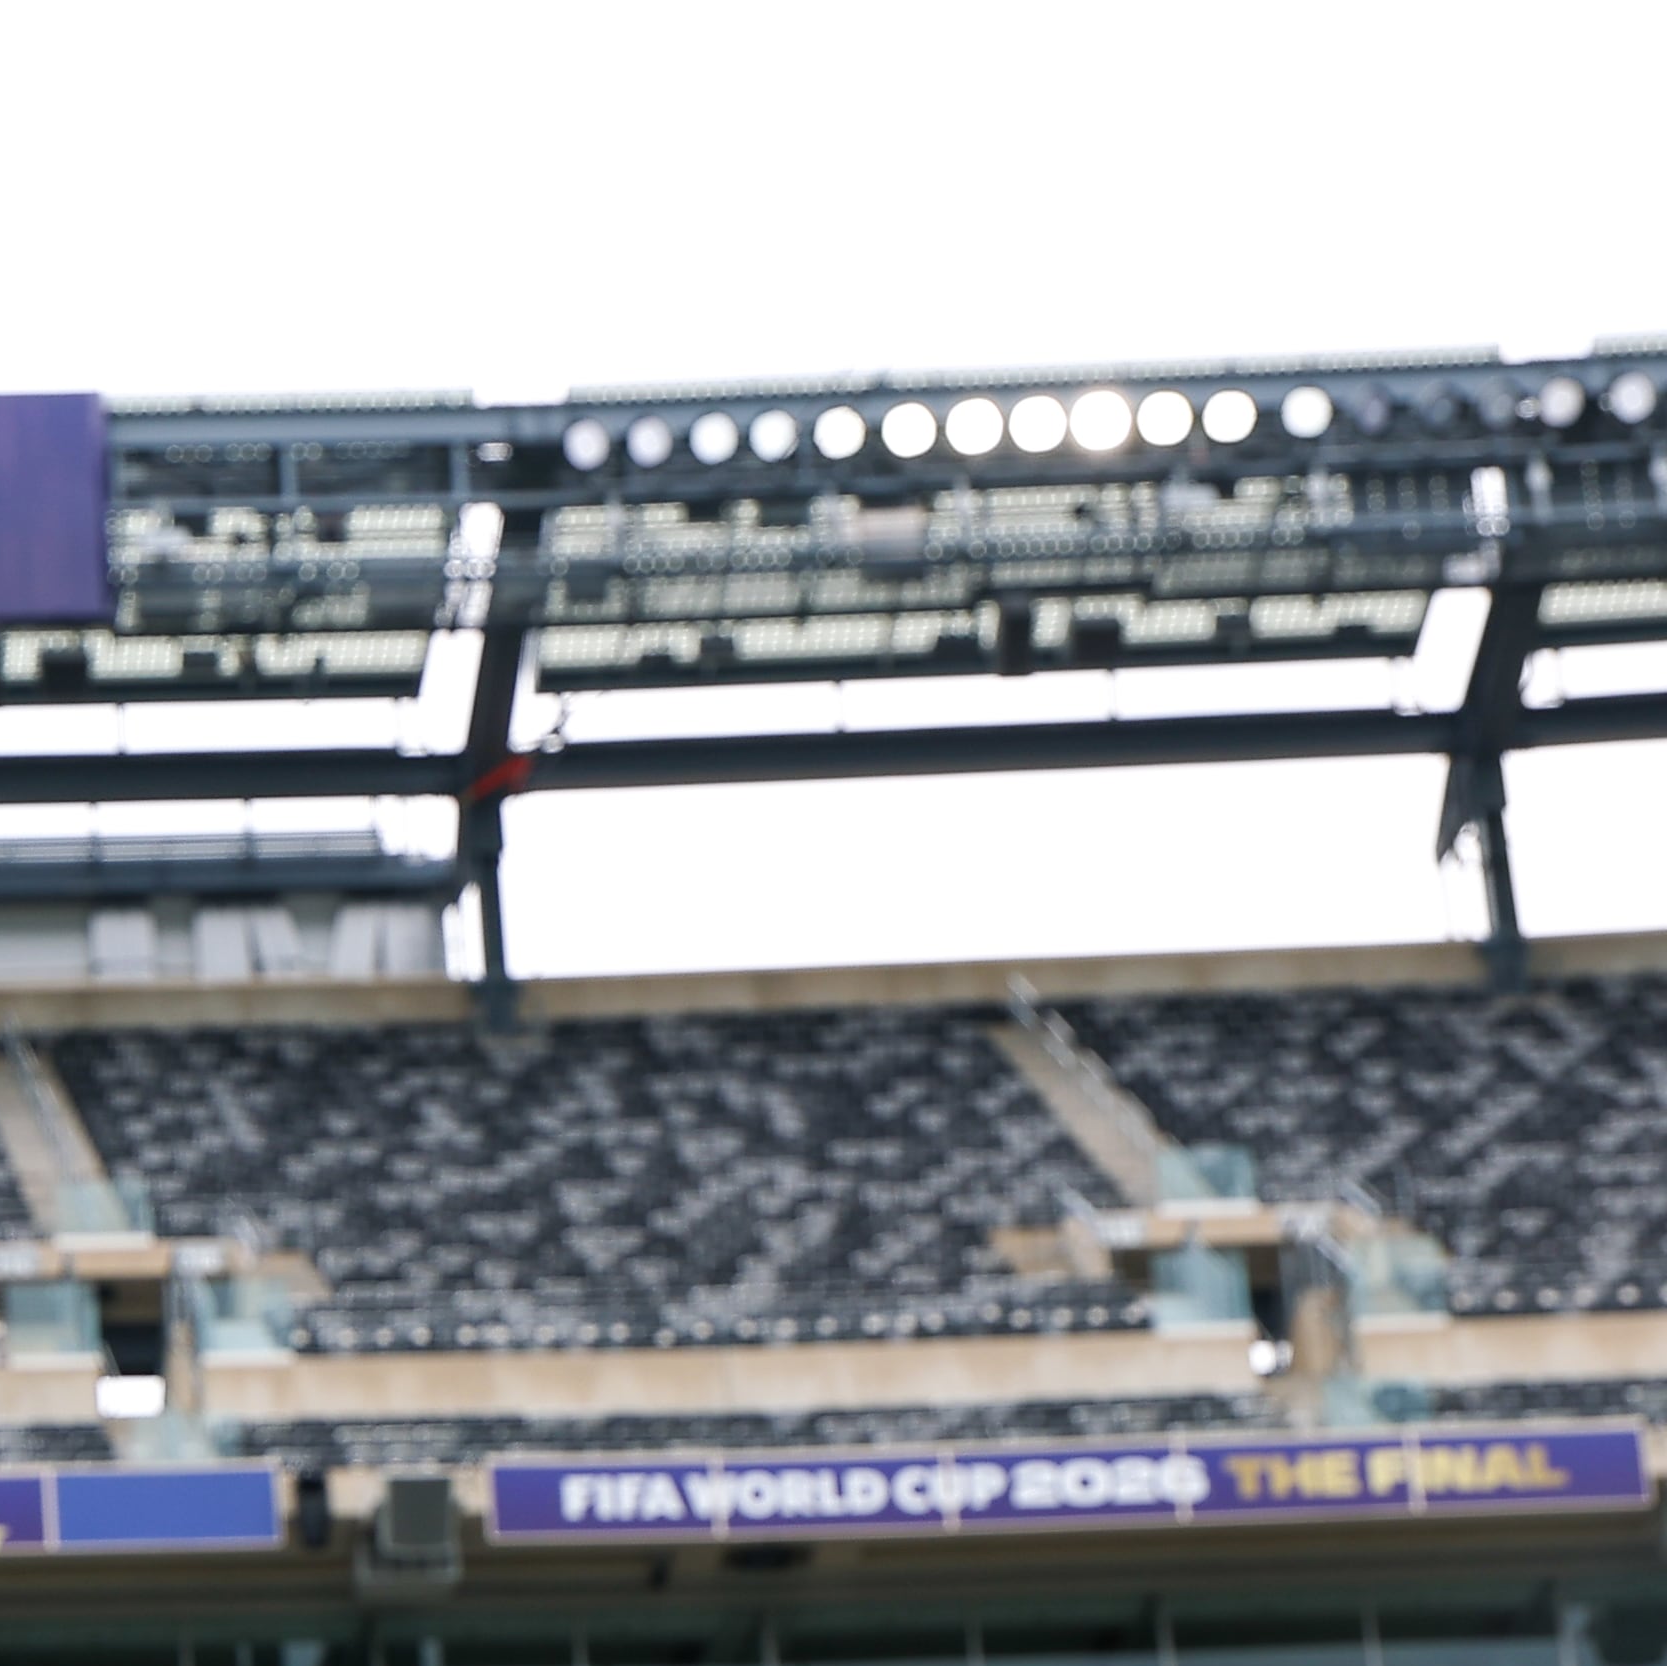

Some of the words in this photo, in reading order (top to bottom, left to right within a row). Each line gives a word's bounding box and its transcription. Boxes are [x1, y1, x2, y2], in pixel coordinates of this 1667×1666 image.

[560, 1471, 686, 1522] FIFA
[683, 1466, 889, 1520] WORLD
[893, 1462, 1007, 1515] CUP
[1009, 1454, 1210, 1509] 2026
[1223, 1449, 1363, 1500] THE
[1366, 1443, 1569, 1497] FINAL
